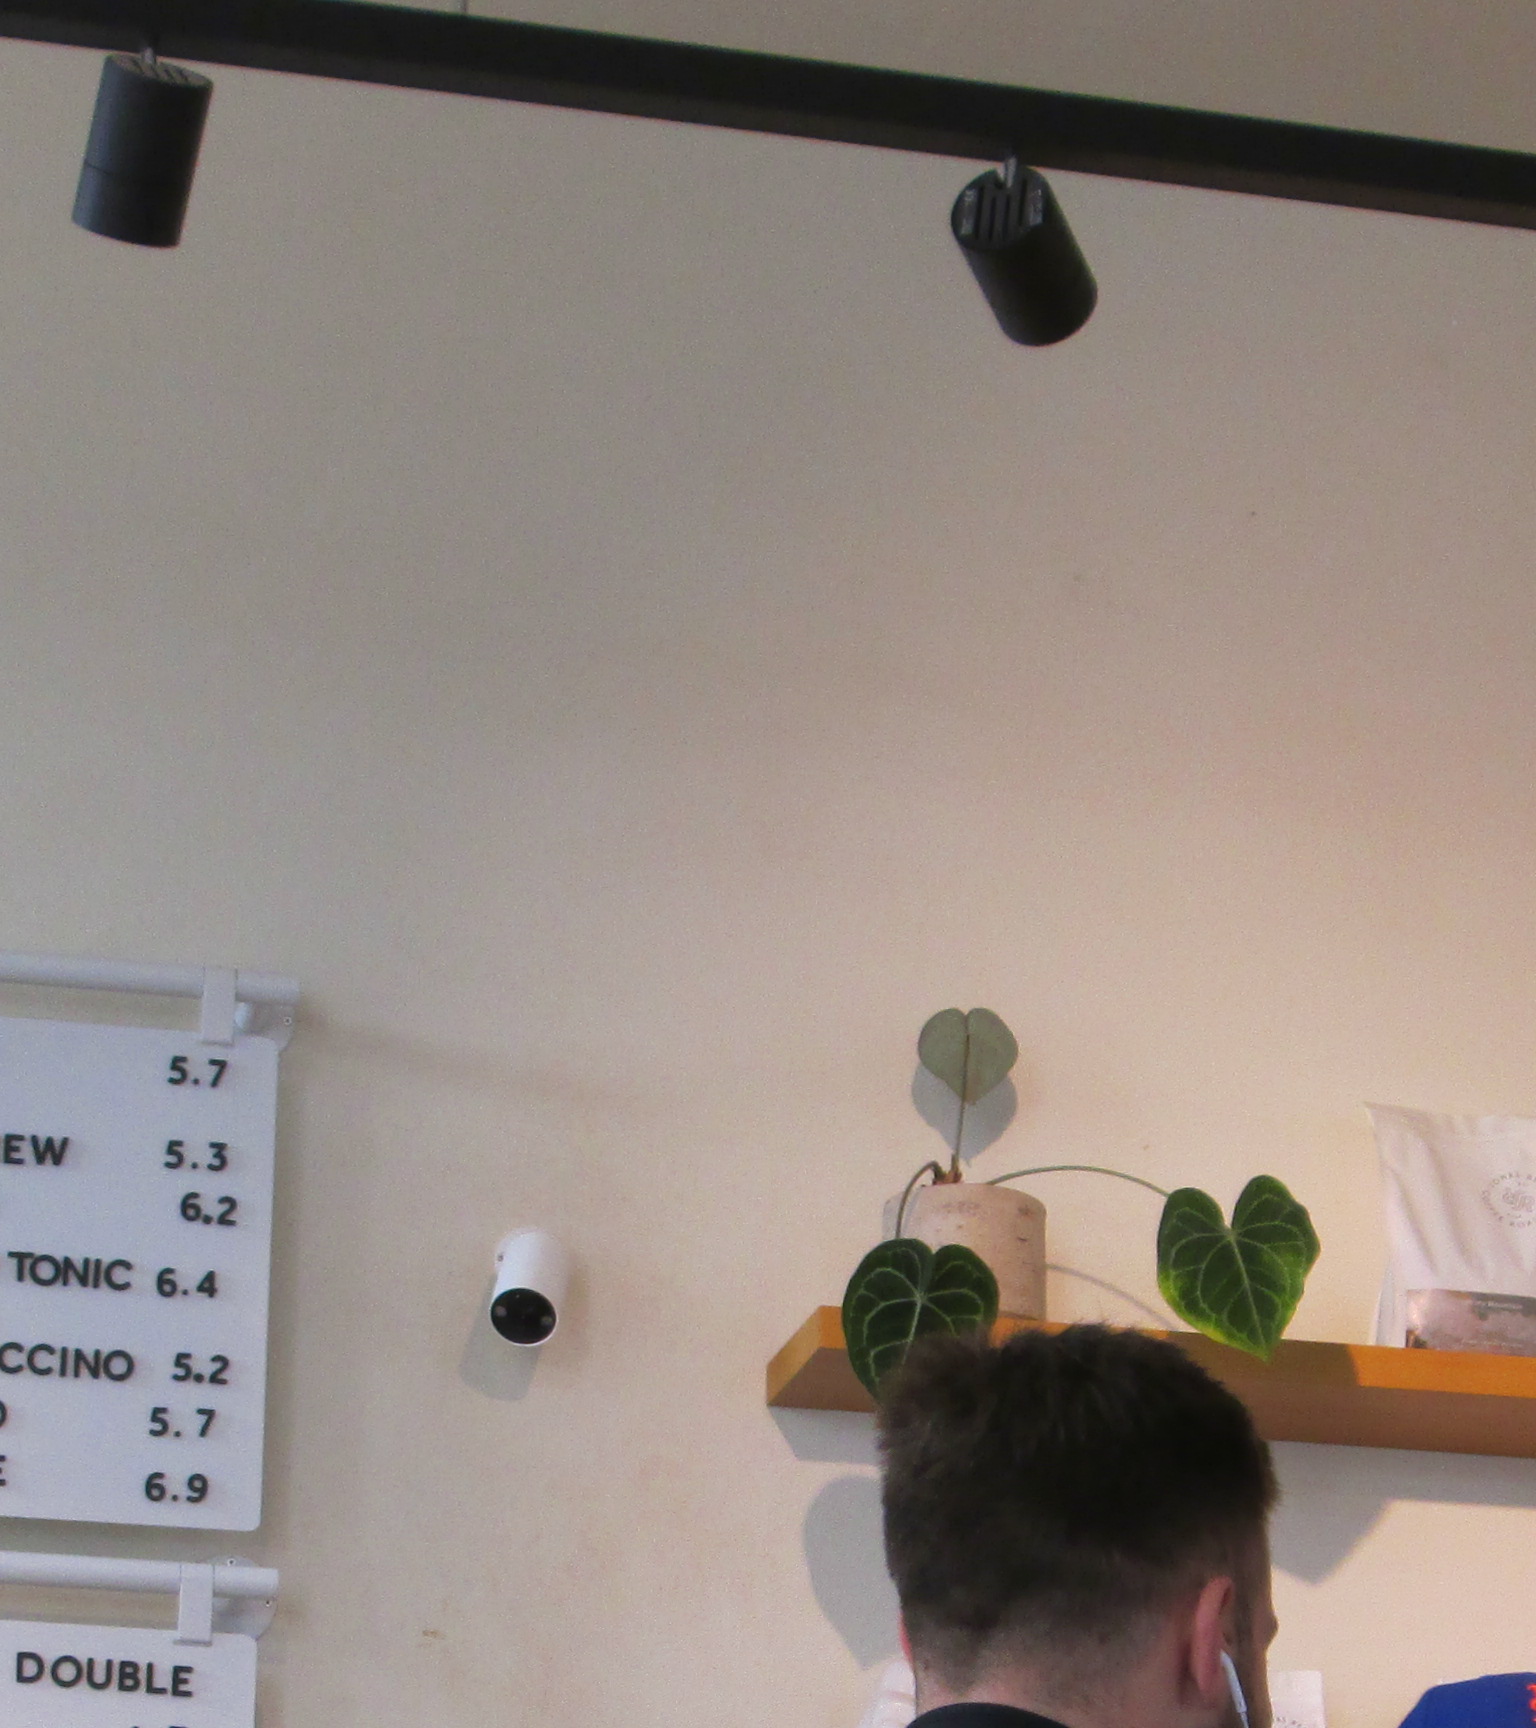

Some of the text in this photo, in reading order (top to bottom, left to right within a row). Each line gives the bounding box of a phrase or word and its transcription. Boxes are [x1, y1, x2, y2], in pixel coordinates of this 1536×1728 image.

[167, 1055, 228, 1088] 5.7
[164, 1139, 228, 1173] 5.3
[179, 1191, 238, 1227] 6.2
[7, 1251, 134, 1292] TONIC
[155, 1267, 218, 1299] 6.4
[171, 1352, 230, 1386] 5.2
[148, 1406, 216, 1438] 5.7
[144, 1471, 209, 1504] 6.9
[15, 1651, 194, 1699] DOUBLE
